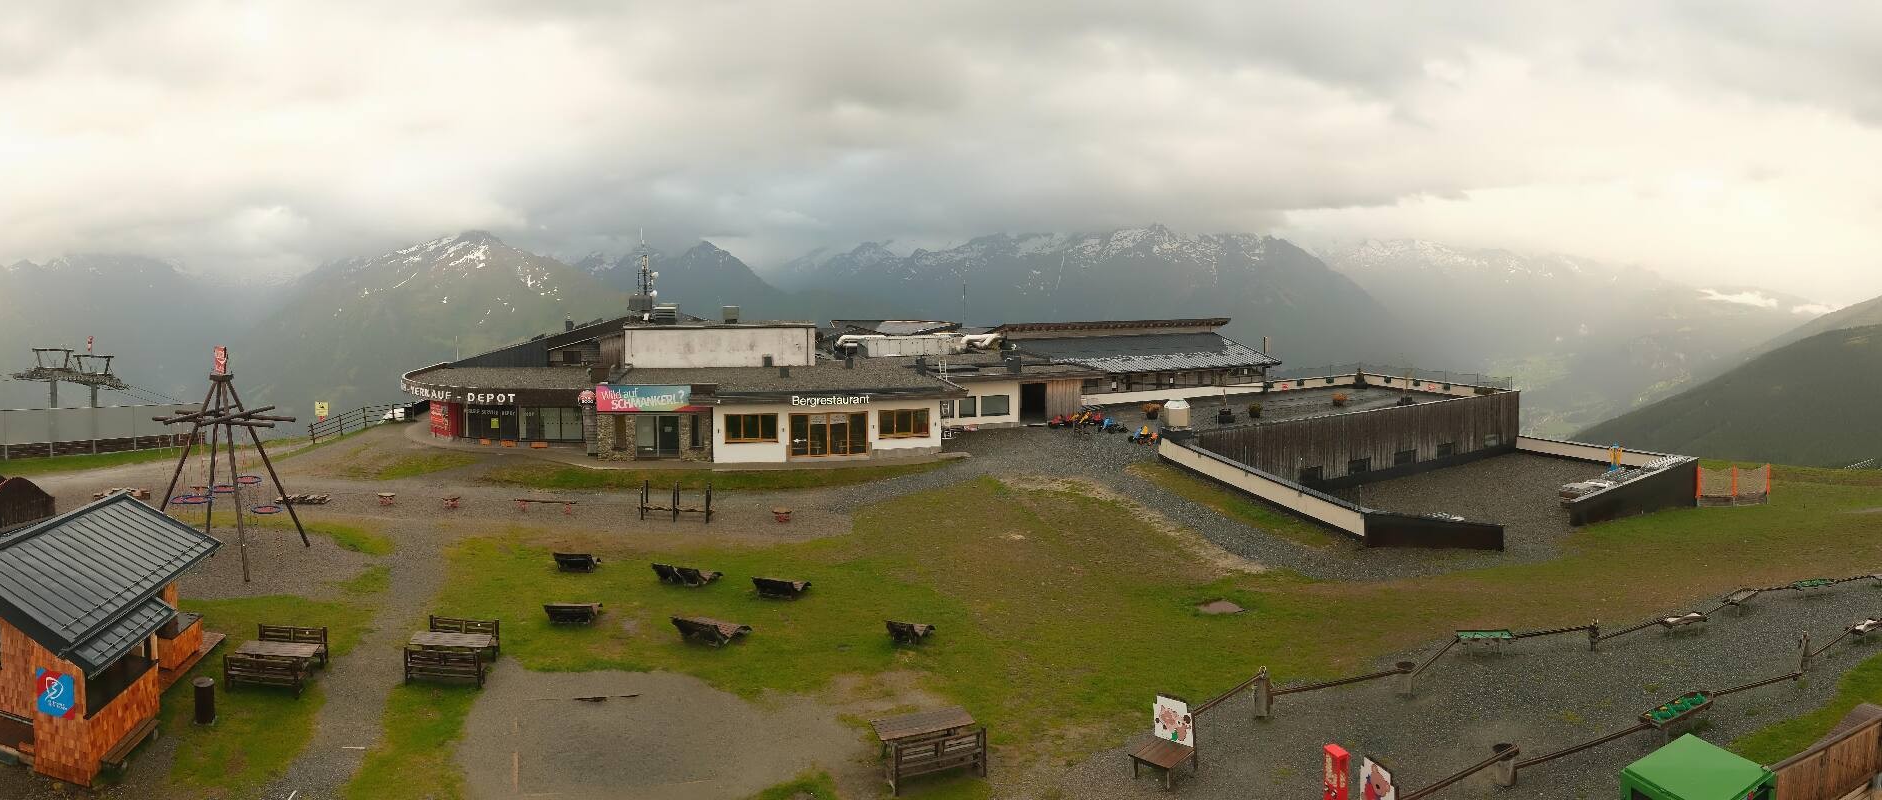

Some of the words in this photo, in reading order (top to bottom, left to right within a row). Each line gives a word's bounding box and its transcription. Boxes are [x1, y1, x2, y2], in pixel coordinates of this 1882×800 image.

[411, 386, 452, 399] VERKAUF
[467, 392, 516, 403] DEPOT
[601, 389, 622, 400] Wild
[623, 388, 639, 399] auf
[611, 389, 685, 410] SCHMANKERL?
[791, 395, 870, 407] Bergrestaurant
